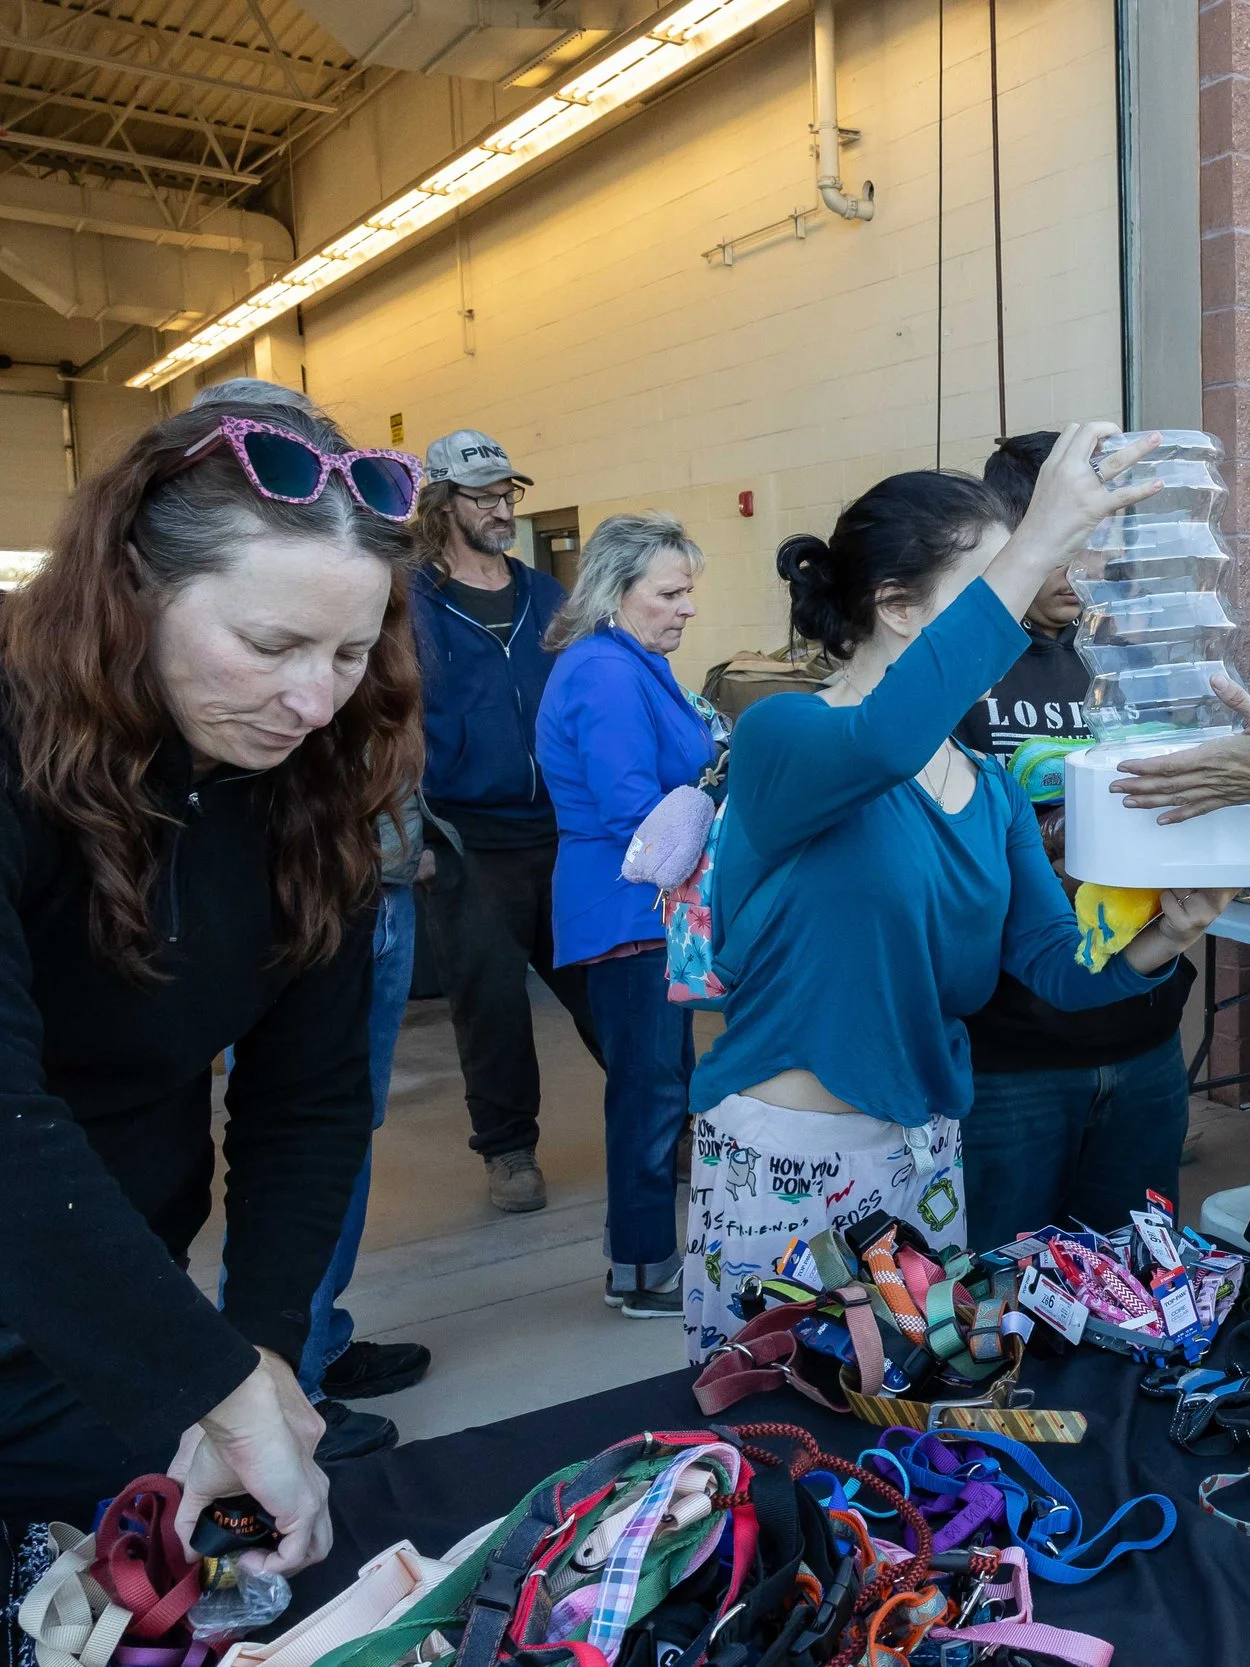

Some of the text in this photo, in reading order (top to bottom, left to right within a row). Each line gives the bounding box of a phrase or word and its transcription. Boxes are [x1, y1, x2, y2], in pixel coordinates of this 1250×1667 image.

[461, 446, 507, 462] PING
[769, 1156, 840, 1179] HOW YOU
[831, 1189, 882, 1232] ROSS
